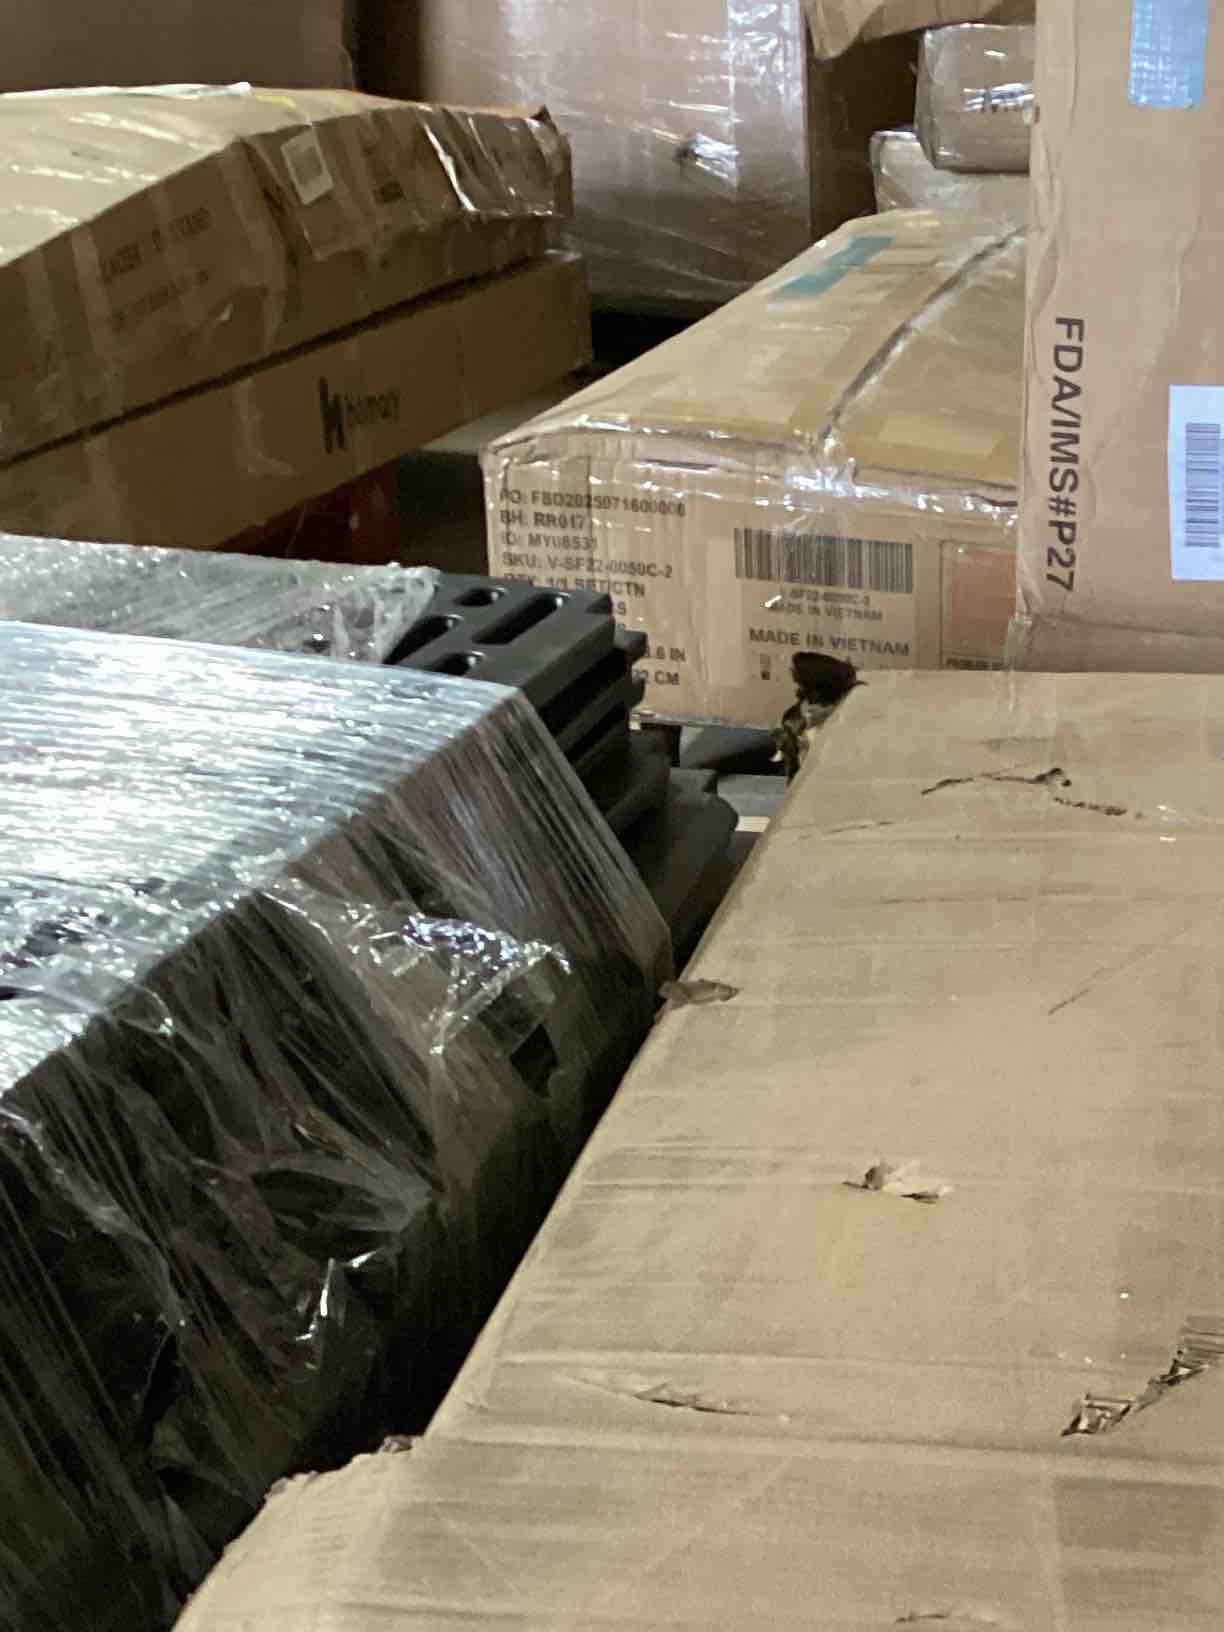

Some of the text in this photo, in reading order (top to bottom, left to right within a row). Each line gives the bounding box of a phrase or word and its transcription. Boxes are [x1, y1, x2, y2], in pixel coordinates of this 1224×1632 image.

[1046, 317, 1084, 592] FDA/IMS#P27
[750, 627, 909, 656] MADE IN VIETNAM
